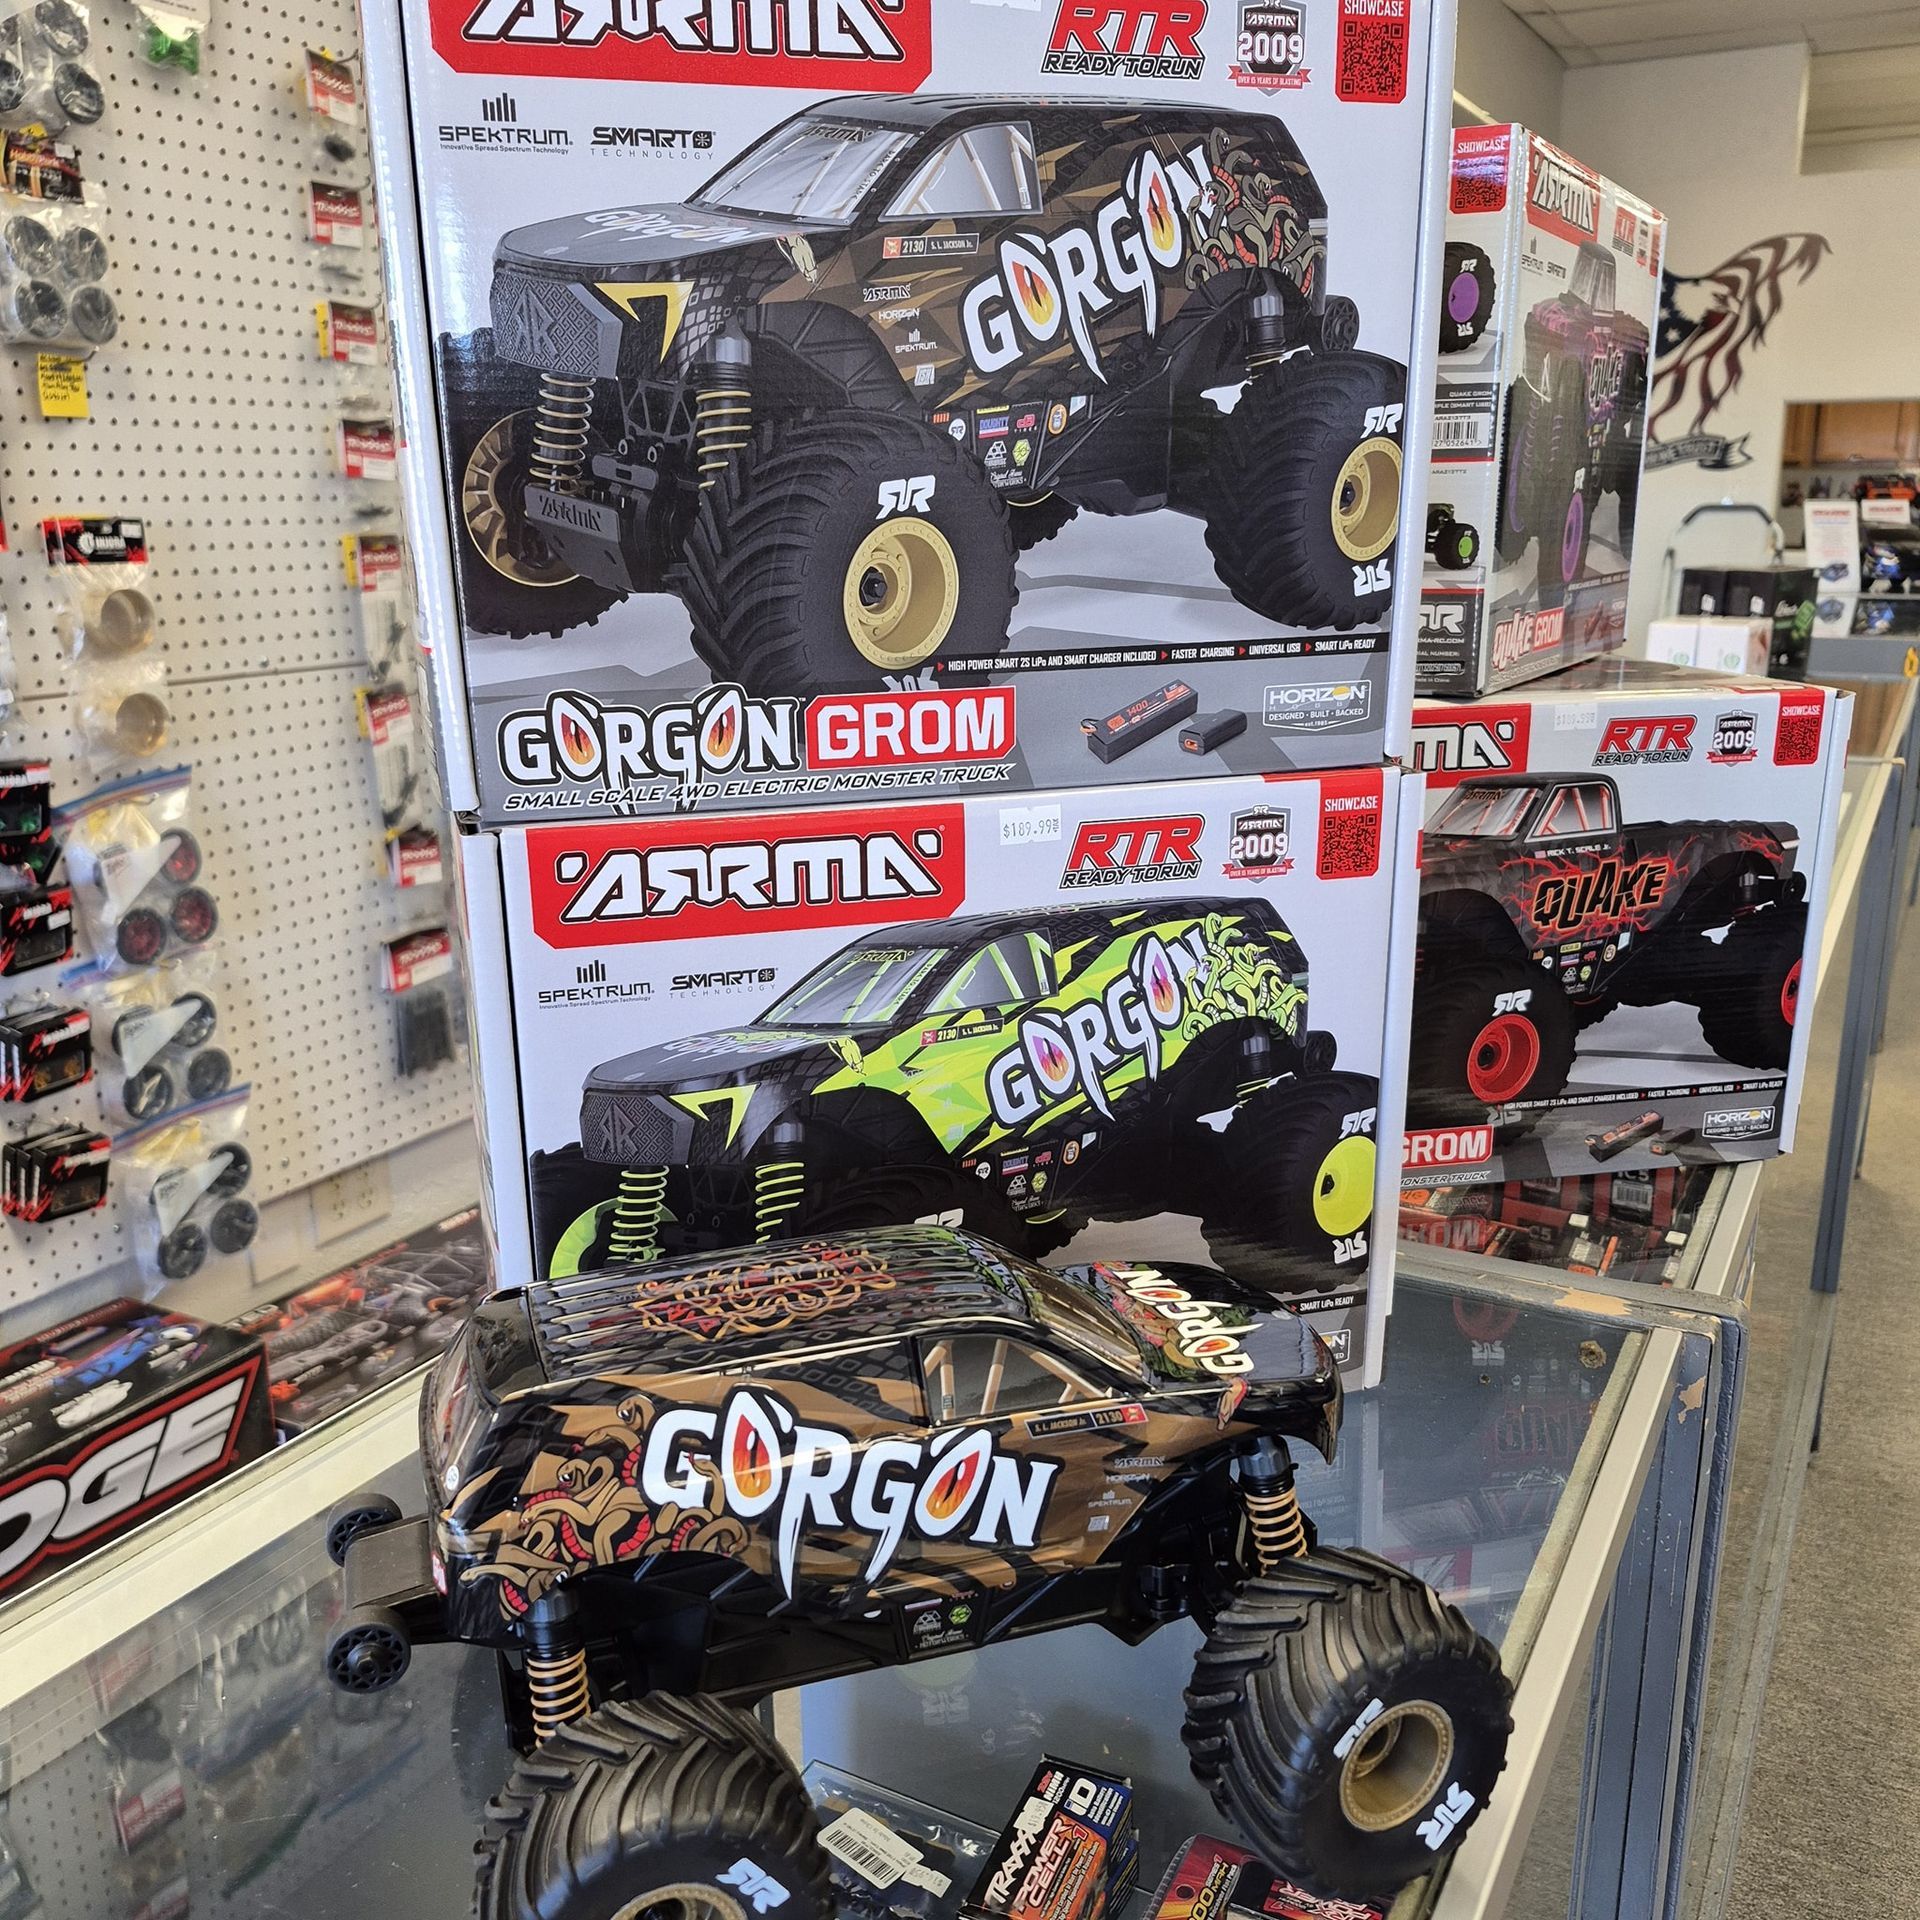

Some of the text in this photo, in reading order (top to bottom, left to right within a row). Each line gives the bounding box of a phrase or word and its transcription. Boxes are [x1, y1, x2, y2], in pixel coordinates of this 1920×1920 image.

[1344, 0, 1404, 17] SHOWCASE
[1050, 0, 1205, 57] RTR
[1237, 32, 1304, 63] 2009
[1044, 53, 1204, 79] READY TO RUN
[440, 126, 569, 146] SPEKTRUM
[590, 126, 692, 148] SMART
[1457, 139, 1506, 154] SHOWCASE
[440, 144, 568, 155] Innovative Spread Spectrum Technology
[591, 149, 713, 160] TECHNOLOGY
[902, 241, 924, 252] 2130
[943, 241, 965, 249] JACKSON
[1492, 609, 1536, 671] QUAKE
[1534, 611, 1564, 647] GROM
[949, 661, 966, 671] HIGH
[968, 660, 994, 670] POWER
[995, 658, 1019, 669] SMART
[1021, 658, 1030, 668] 2S
[1031, 657, 1047, 667] LiPo
[1048, 656, 1063, 666] AND
[1064, 654, 1088, 665] SMART
[1089, 652, 1122, 664] CHARGER
[1123, 650, 1156, 662] INCLUDED
[1171, 649, 1197, 659] FASTER
[1200, 647, 1235, 658] CHARGING
[1249, 644, 1285, 655] UNIVERSAL
[1287, 643, 1301, 653] USB
[1315, 641, 1337, 652] SMART
[1354, 639, 1376, 649] READY
[1270, 685, 1367, 704] HORIZON
[1269, 708, 1363, 721] DESIGNED BUILT BACKED
[1782, 705, 1821, 716] SHOWCASE
[1599, 716, 1697, 751] RTR
[1714, 730, 1755, 749] 2009
[502, 687, 1008, 808] GORGON GROM
[1594, 751, 1691, 765] READY TO RUN
[504, 762, 1016, 811] SMALL SCALE 4WD ELECTRIC MONSTER TRUCK
[1325, 796, 1378, 812] SHOWCASE
[1003, 819, 1052, 839] $189.99
[1067, 815, 1204, 871] RTR
[1230, 833, 1288, 860] 2009
[557, 830, 942, 923] ARRMA
[1062, 863, 1200, 888] READY TO RUN
[1533, 859, 1669, 931] QUAKE
[670, 969, 758, 991] SMART
[538, 982, 651, 1003] SPEKTRUM
[592, 999, 619, 1007] Spectrum
[620, 996, 651, 1004] Technology
[669, 983, 776, 999] TECHNOLOGY
[937, 1029, 956, 1040] 2130
[990, 928, 1216, 1122] GORGON
[1516, 1101, 1532, 1109] POWER
[1533, 1099, 1549, 1108] SMART
[1578, 1096, 1593, 1104] SMART
[1594, 1094, 1615, 1103] CHARGER
[1616, 1092, 1638, 1101] INCLUDED
[1648, 1090, 1665, 1098] FASTER
[1667, 1088, 1690, 1097] CHARGING
[1699, 1086, 1723, 1094] UNIVERSAL
[1742, 1083, 1756, 1091] SMART
[1769, 1080, 1784, 1089] READY
[1706, 1109, 1771, 1124] HORIZON
[1450, 1171, 1490, 1182] TRUCK
[1300, 1296, 1354, 1311] SMART LiPo READY
[1112, 1269, 1264, 1374] GORGON
[1050, 1420, 1078, 1429] JACKSON
[1095, 1412, 1123, 1424] 2130
[641, 1389, 1060, 1598] GORGON
[1011, 1818, 1071, 1912] POWER
[1027, 1836, 1071, 1906] CELL
